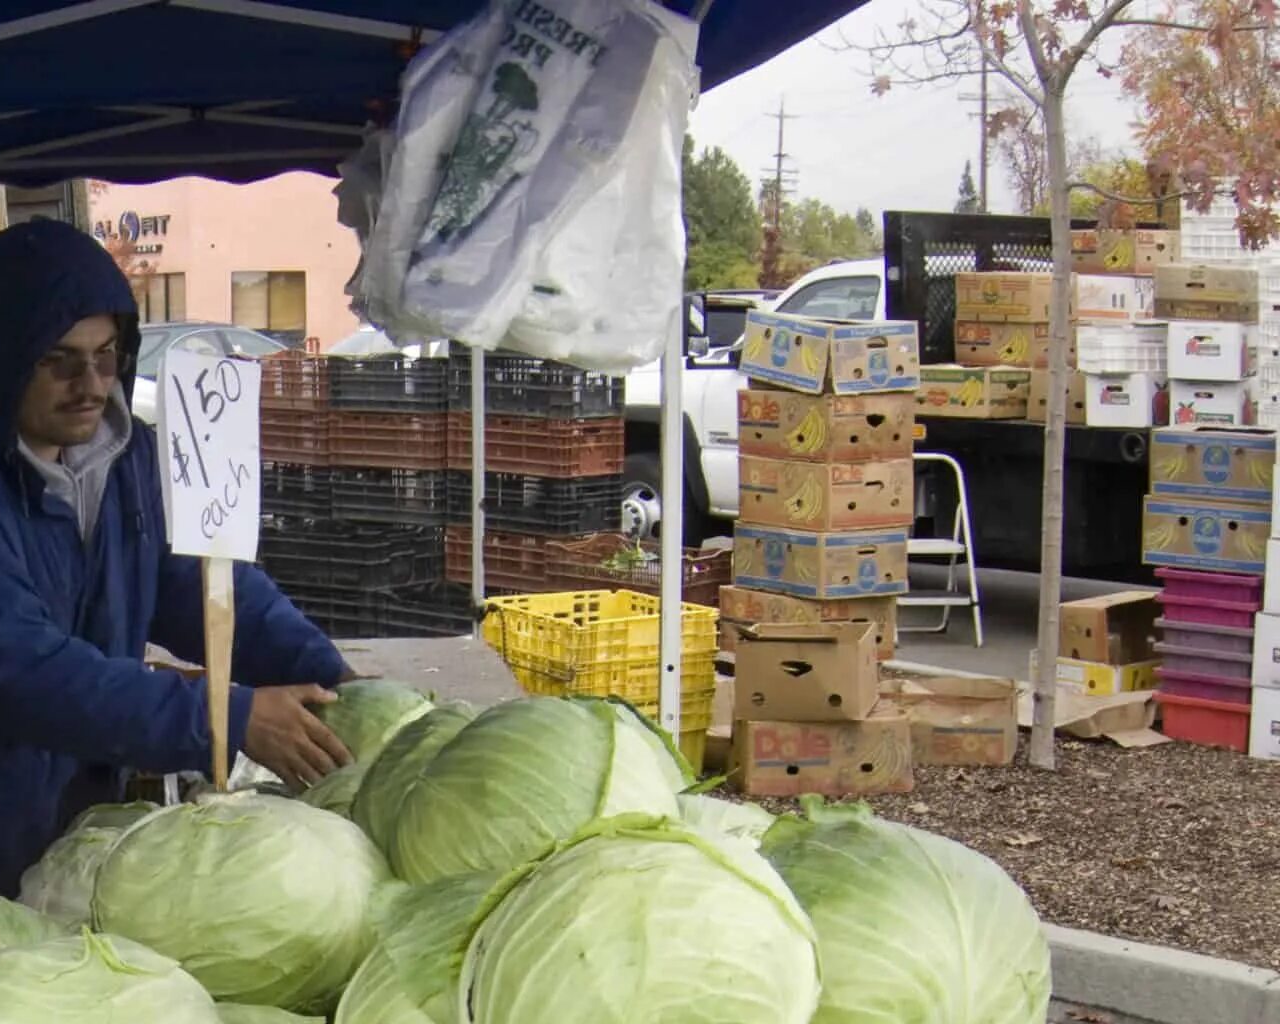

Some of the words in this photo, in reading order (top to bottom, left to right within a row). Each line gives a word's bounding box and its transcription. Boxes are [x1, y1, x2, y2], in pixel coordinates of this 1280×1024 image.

[141, 214, 170, 237] FIT
[172, 359, 241, 488] $1.50
[739, 394, 780, 421] Dole
[201, 458, 250, 539] each
[754, 726, 832, 759] Dole
